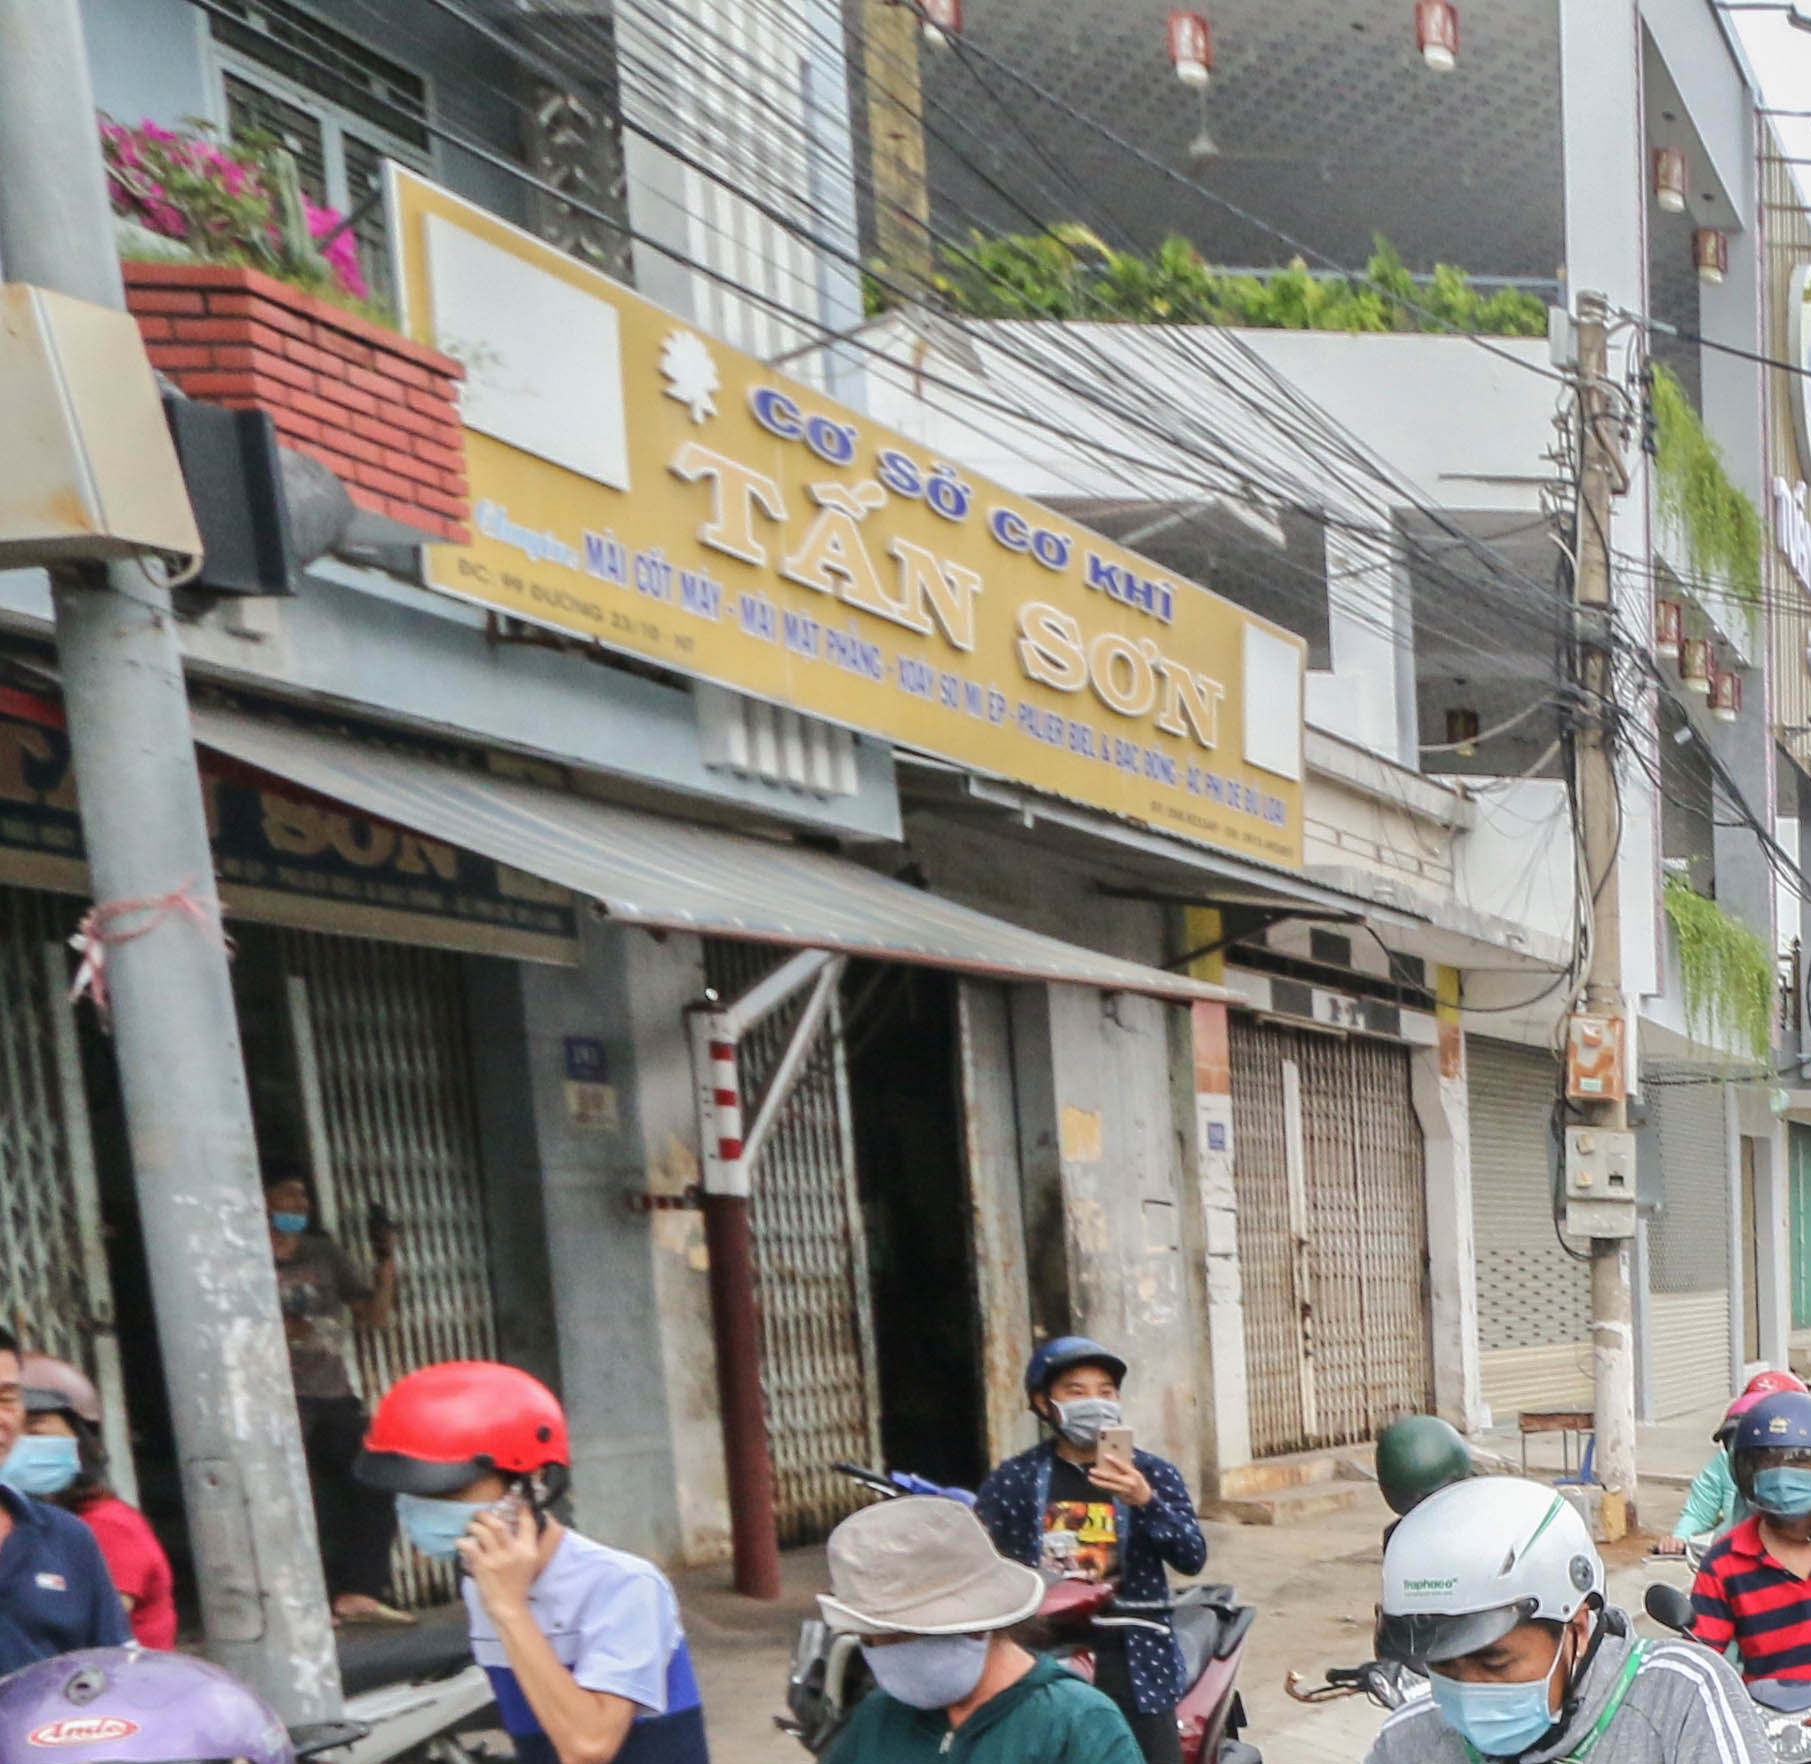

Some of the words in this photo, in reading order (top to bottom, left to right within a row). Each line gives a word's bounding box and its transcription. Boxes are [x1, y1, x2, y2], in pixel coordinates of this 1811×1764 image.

[669, 440, 983, 653] TẤN
[1016, 599, 1226, 750] SƠN
[749, 385, 858, 467] CƠ
[877, 447, 974, 523] SỞ
[987, 505, 1072, 574] CƠ
